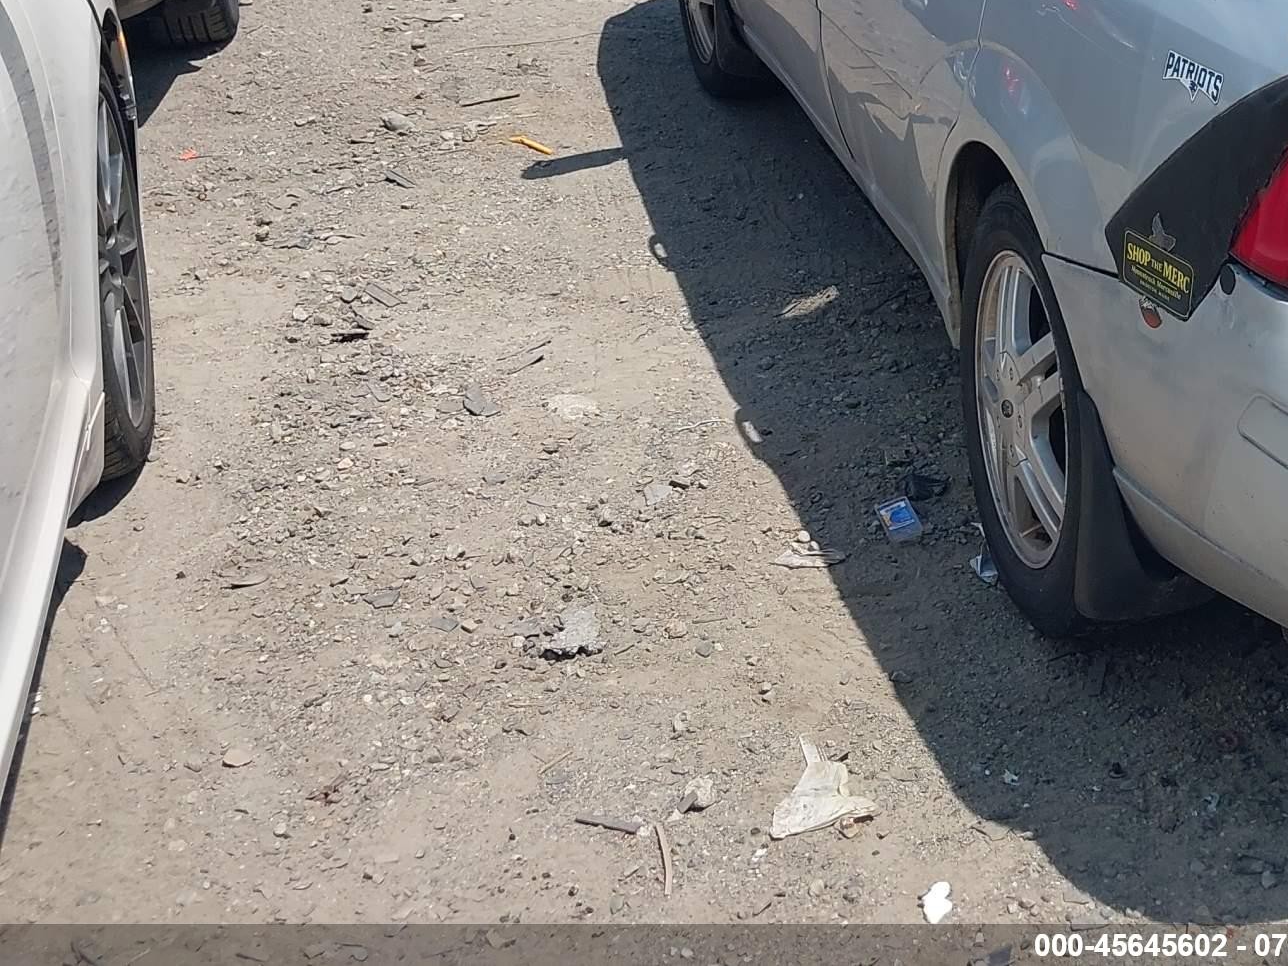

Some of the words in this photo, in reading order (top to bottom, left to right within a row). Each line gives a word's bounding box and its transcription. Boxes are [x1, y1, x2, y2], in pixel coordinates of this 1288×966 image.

[1164, 52, 1222, 102] PATRIOTS
[1126, 242, 1151, 266] SHOP
[1151, 258, 1163, 273] THE
[1162, 260, 1190, 294] MERC
